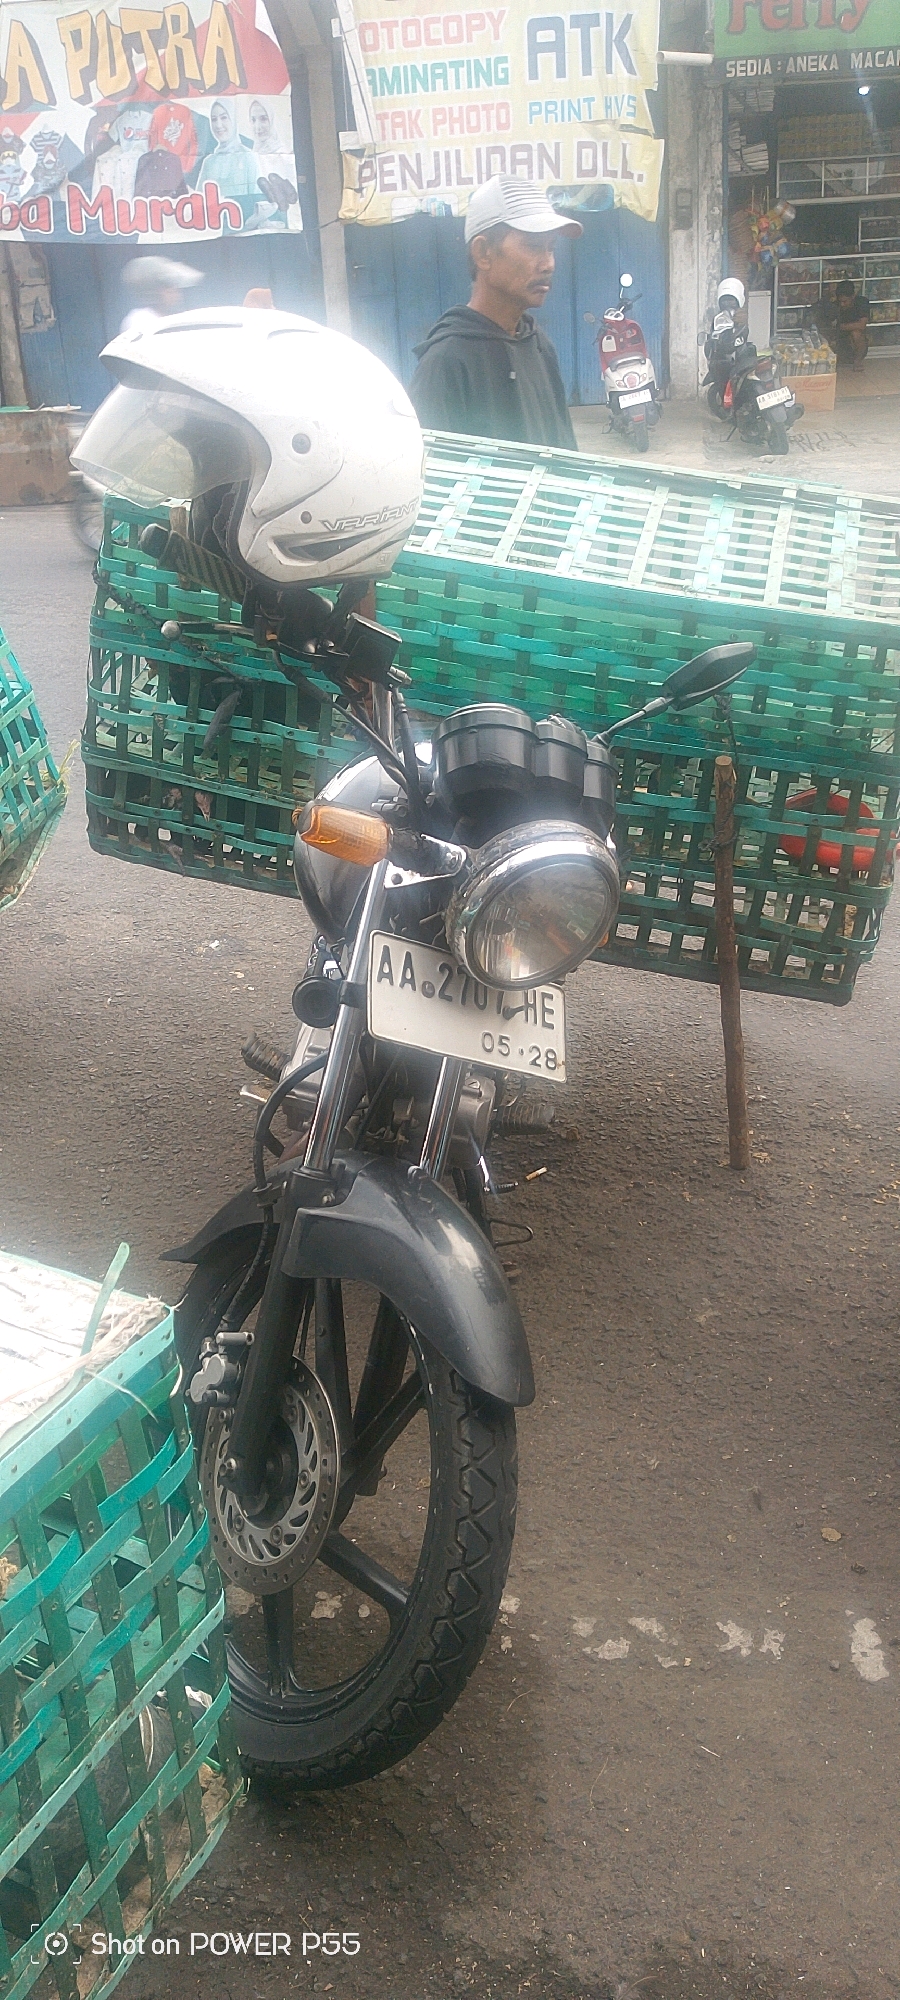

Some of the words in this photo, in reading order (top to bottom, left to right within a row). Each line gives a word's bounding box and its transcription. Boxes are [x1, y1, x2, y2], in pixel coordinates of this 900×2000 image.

[56, 1, 243, 100] PUTRA
[527, 12, 637, 80] ATK
[726, 58, 772, 78] SEDIA
[785, 54, 839, 74] ANEKA
[376, 109, 424, 141] TAK
[432, 102, 511, 136] PHOTO
[528, 97, 595, 124] PRINT
[604, 95, 637, 119] HVS
[576, 140, 644, 183] DLL.
[66, 182, 243, 234] Murah
[376, 944, 417, 992] AA
[524, 988, 555, 1030] HE
